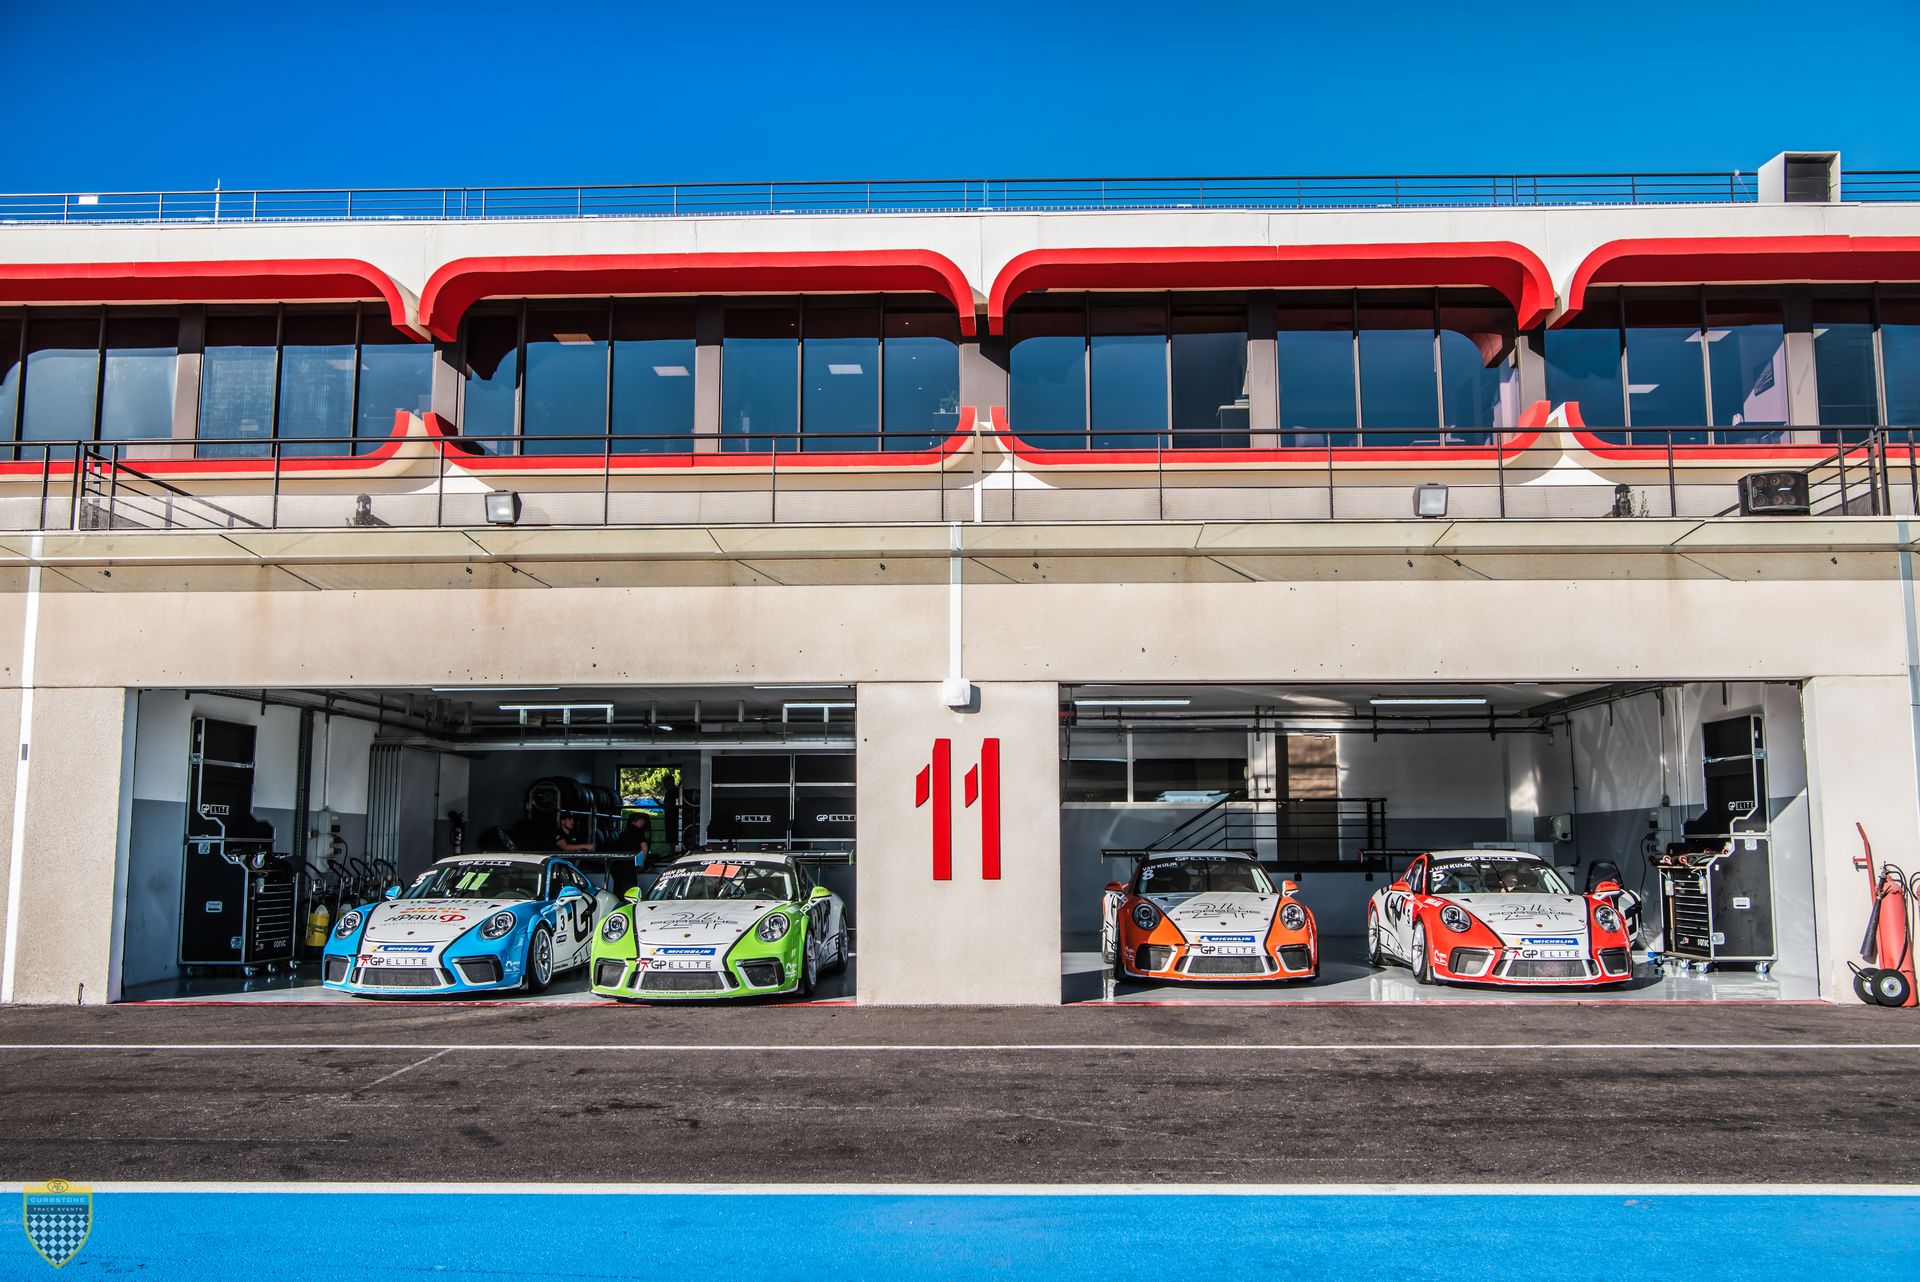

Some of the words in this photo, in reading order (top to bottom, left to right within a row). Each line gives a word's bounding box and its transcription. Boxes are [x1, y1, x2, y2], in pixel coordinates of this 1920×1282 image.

[201, 804, 210, 813] GP
[210, 804, 230, 815] ELITE
[915, 738, 1001, 880] 11
[1736, 801, 1754, 810] ELITE
[1143, 870, 1154, 880] 8
[1432, 871, 1445, 881] 5
[654, 879, 669, 890] 4
[560, 914, 565, 931] 3
[1201, 946, 1216, 954] GP
[1217, 946, 1256, 954] ELITE
[1522, 949, 1538, 958] GP
[1540, 950, 1579, 958] ELITE
[370, 957, 384, 965] GP
[386, 957, 427, 966] ELITE
[651, 961, 666, 969] GP
[668, 960, 711, 970] ELITE
